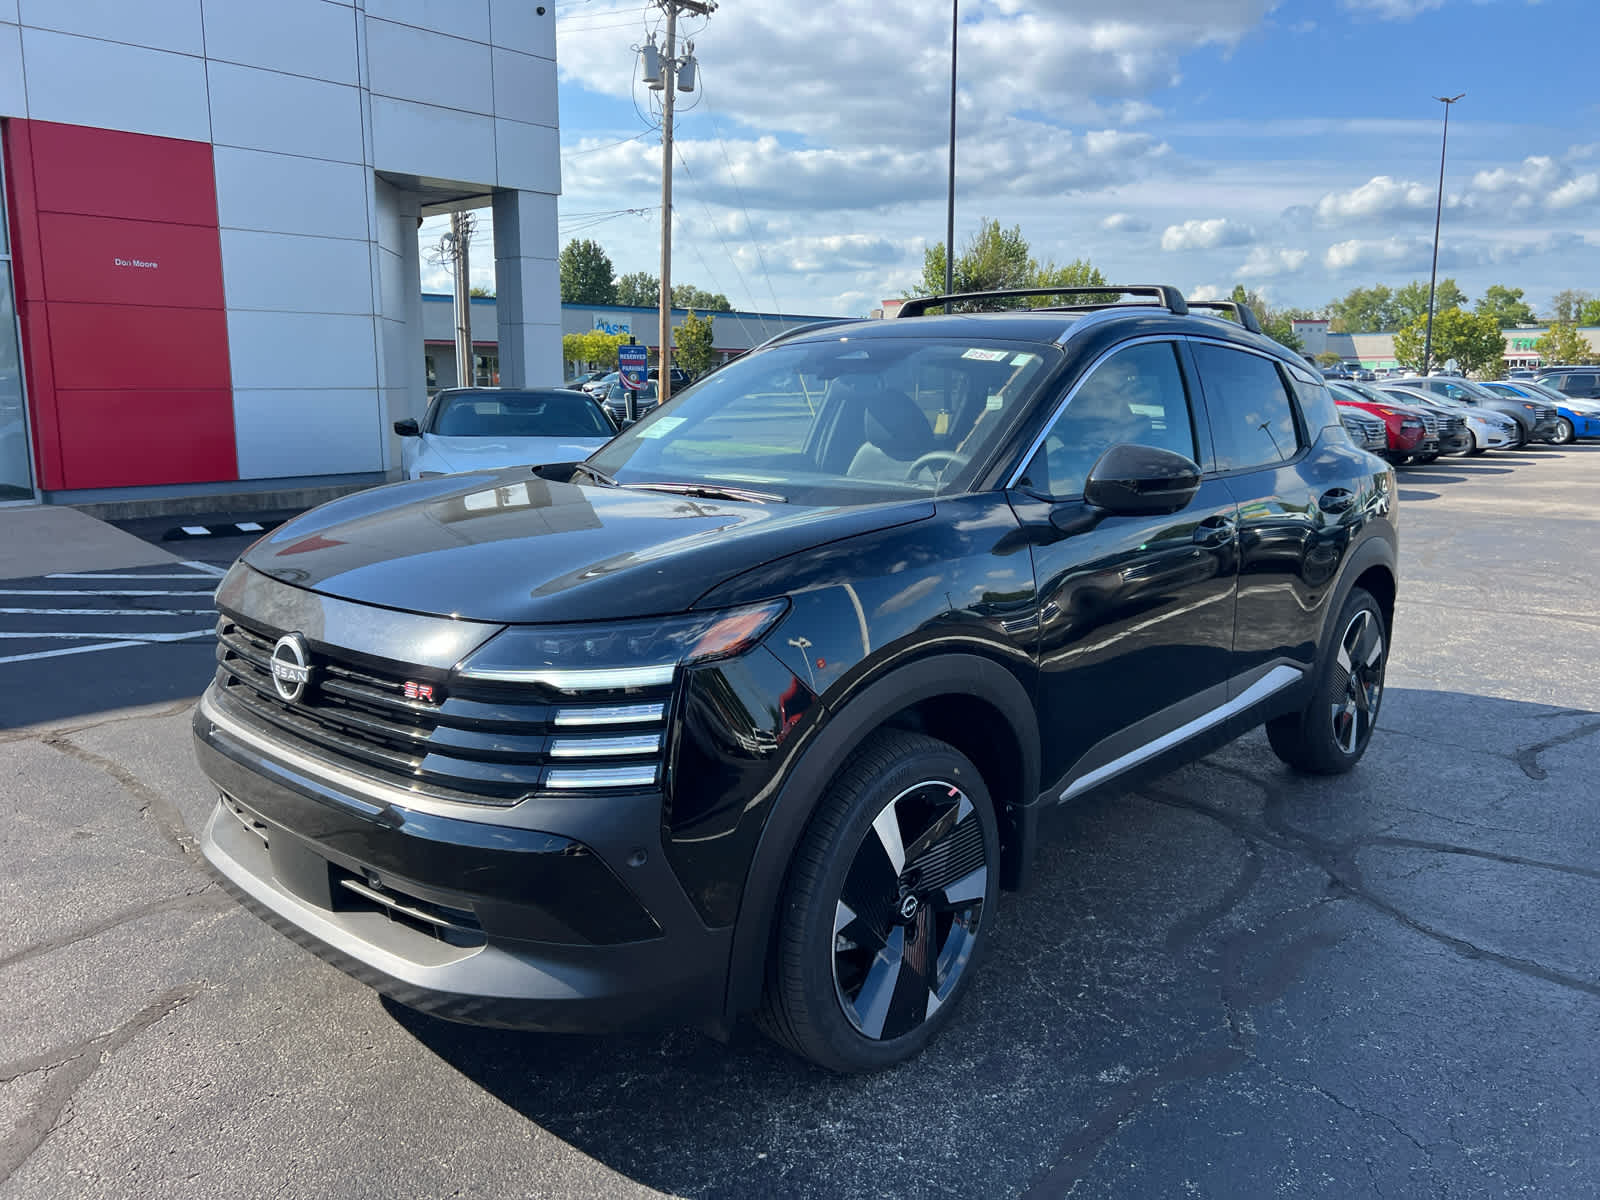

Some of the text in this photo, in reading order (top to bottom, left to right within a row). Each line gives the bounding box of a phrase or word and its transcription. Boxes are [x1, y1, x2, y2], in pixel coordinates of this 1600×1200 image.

[114, 258, 158, 268] Don Moore
[272, 662, 307, 681] SSAN
[404, 681, 433, 702] SR
